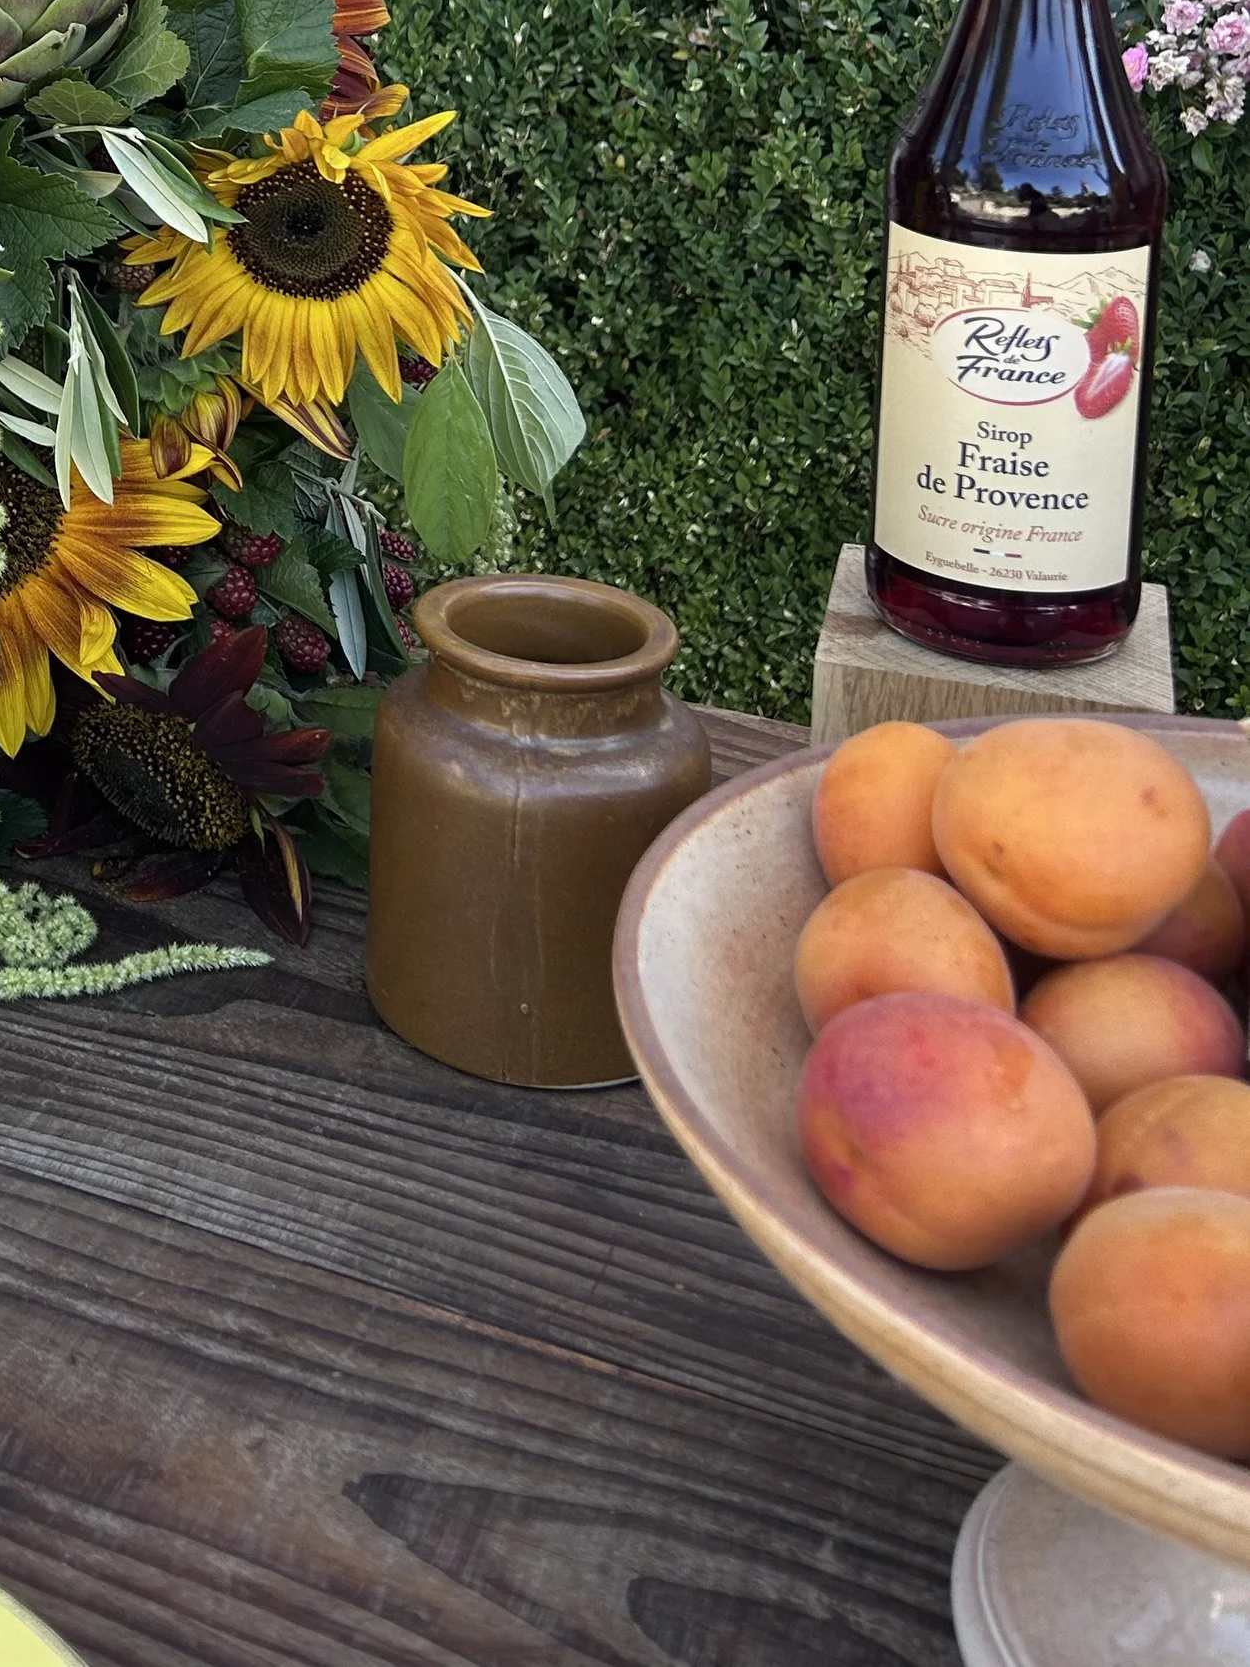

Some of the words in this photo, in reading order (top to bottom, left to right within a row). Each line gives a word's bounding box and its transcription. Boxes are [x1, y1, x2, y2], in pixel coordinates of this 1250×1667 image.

[963, 316, 1060, 362] Reflets
[956, 355, 1066, 384] France
[1003, 355, 1020, 364] de
[976, 421, 1032, 449] Sirop
[957, 440, 1049, 477] Fraise
[917, 465, 946, 494] de
[953, 472, 1089, 509] Provence
[918, 504, 957, 529] Sucre
[961, 521, 1023, 543] origine
[1025, 525, 1083, 542] France
[925, 551, 979, 574] Eyguebelle
[990, 567, 1022, 579] 26230
[1025, 571, 1067, 581] Valaurie
